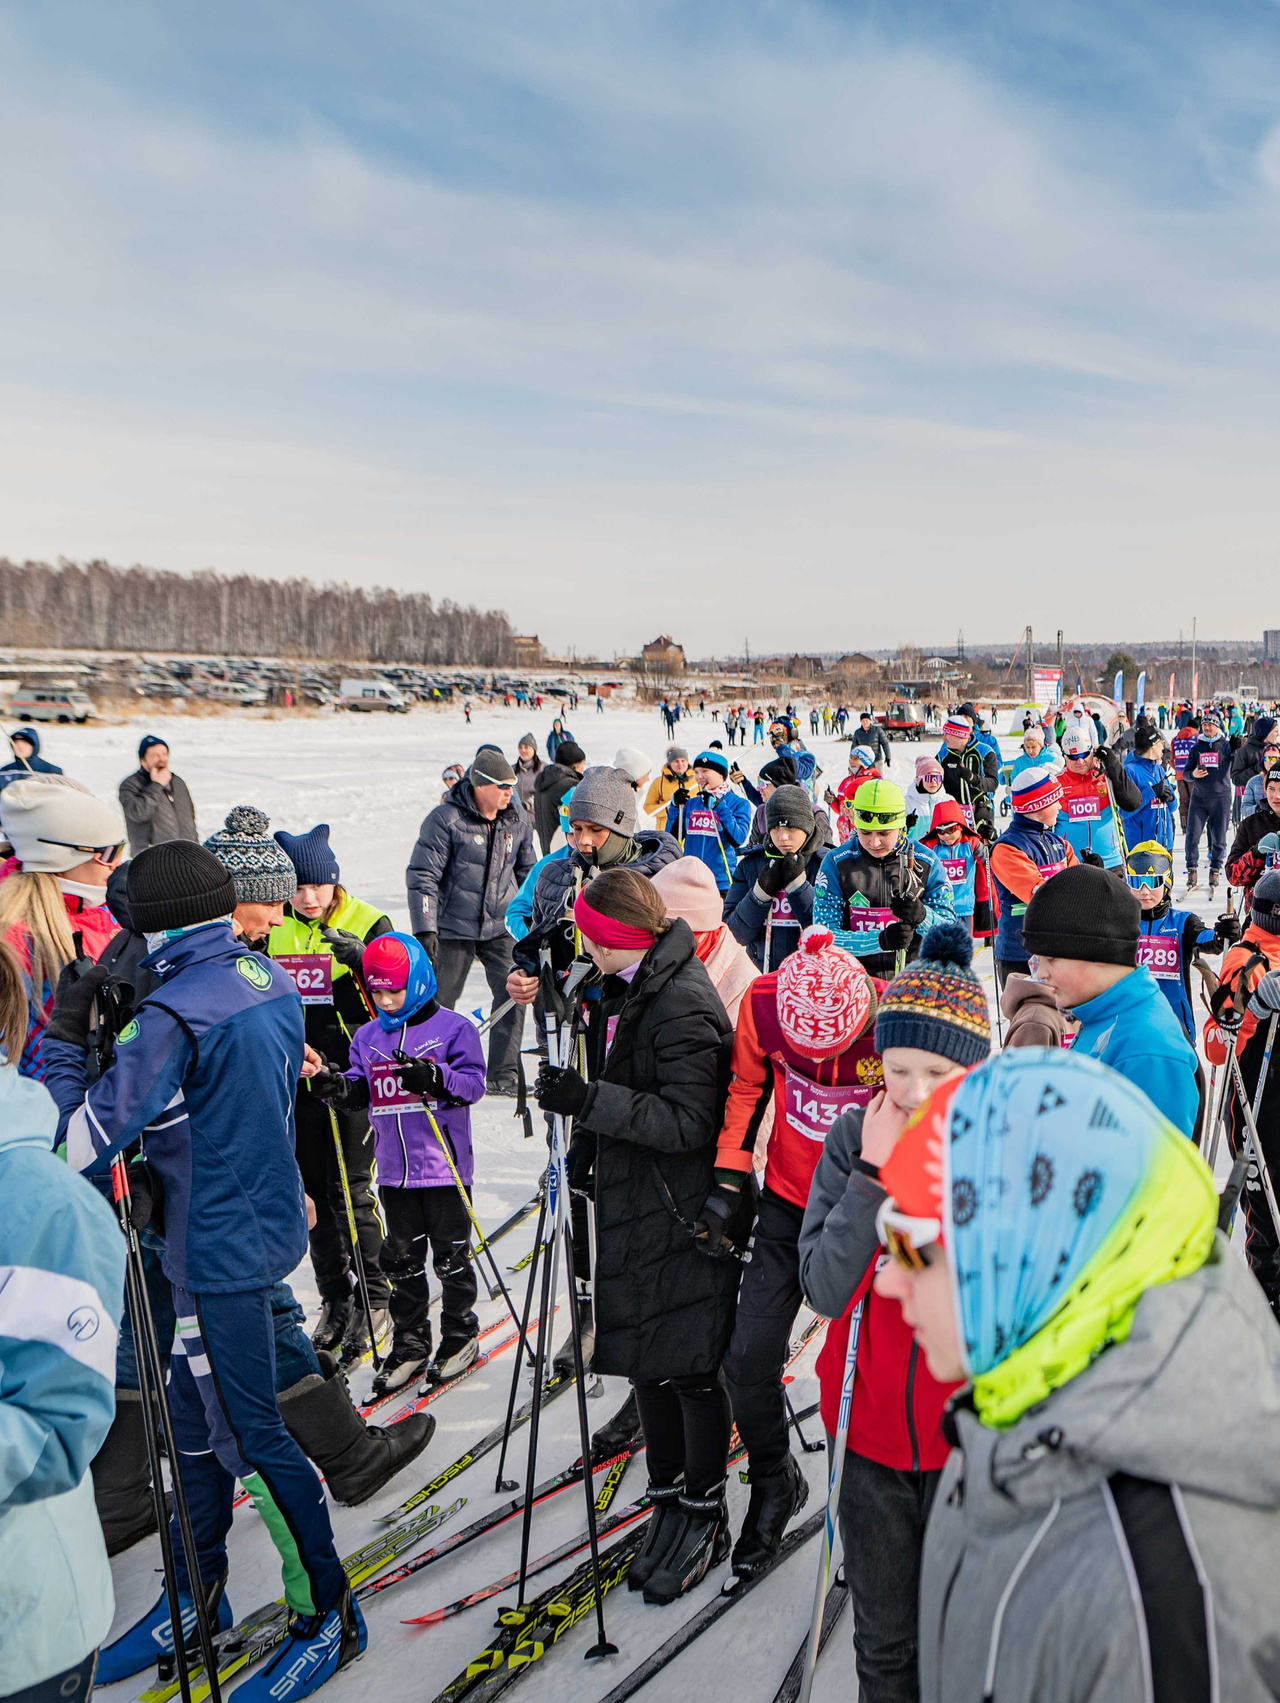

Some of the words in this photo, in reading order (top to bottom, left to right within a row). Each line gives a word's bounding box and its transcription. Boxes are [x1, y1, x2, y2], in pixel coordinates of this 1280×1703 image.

[1201, 755, 1217, 764] 1012
[1070, 803, 1098, 815] 1001
[841, 1299, 865, 1430] SPINE
[401, 1454, 474, 1513] FISCHER
[592, 1450, 633, 1476] ROSSIGNOL
[269, 1615, 343, 1701] SPINE
